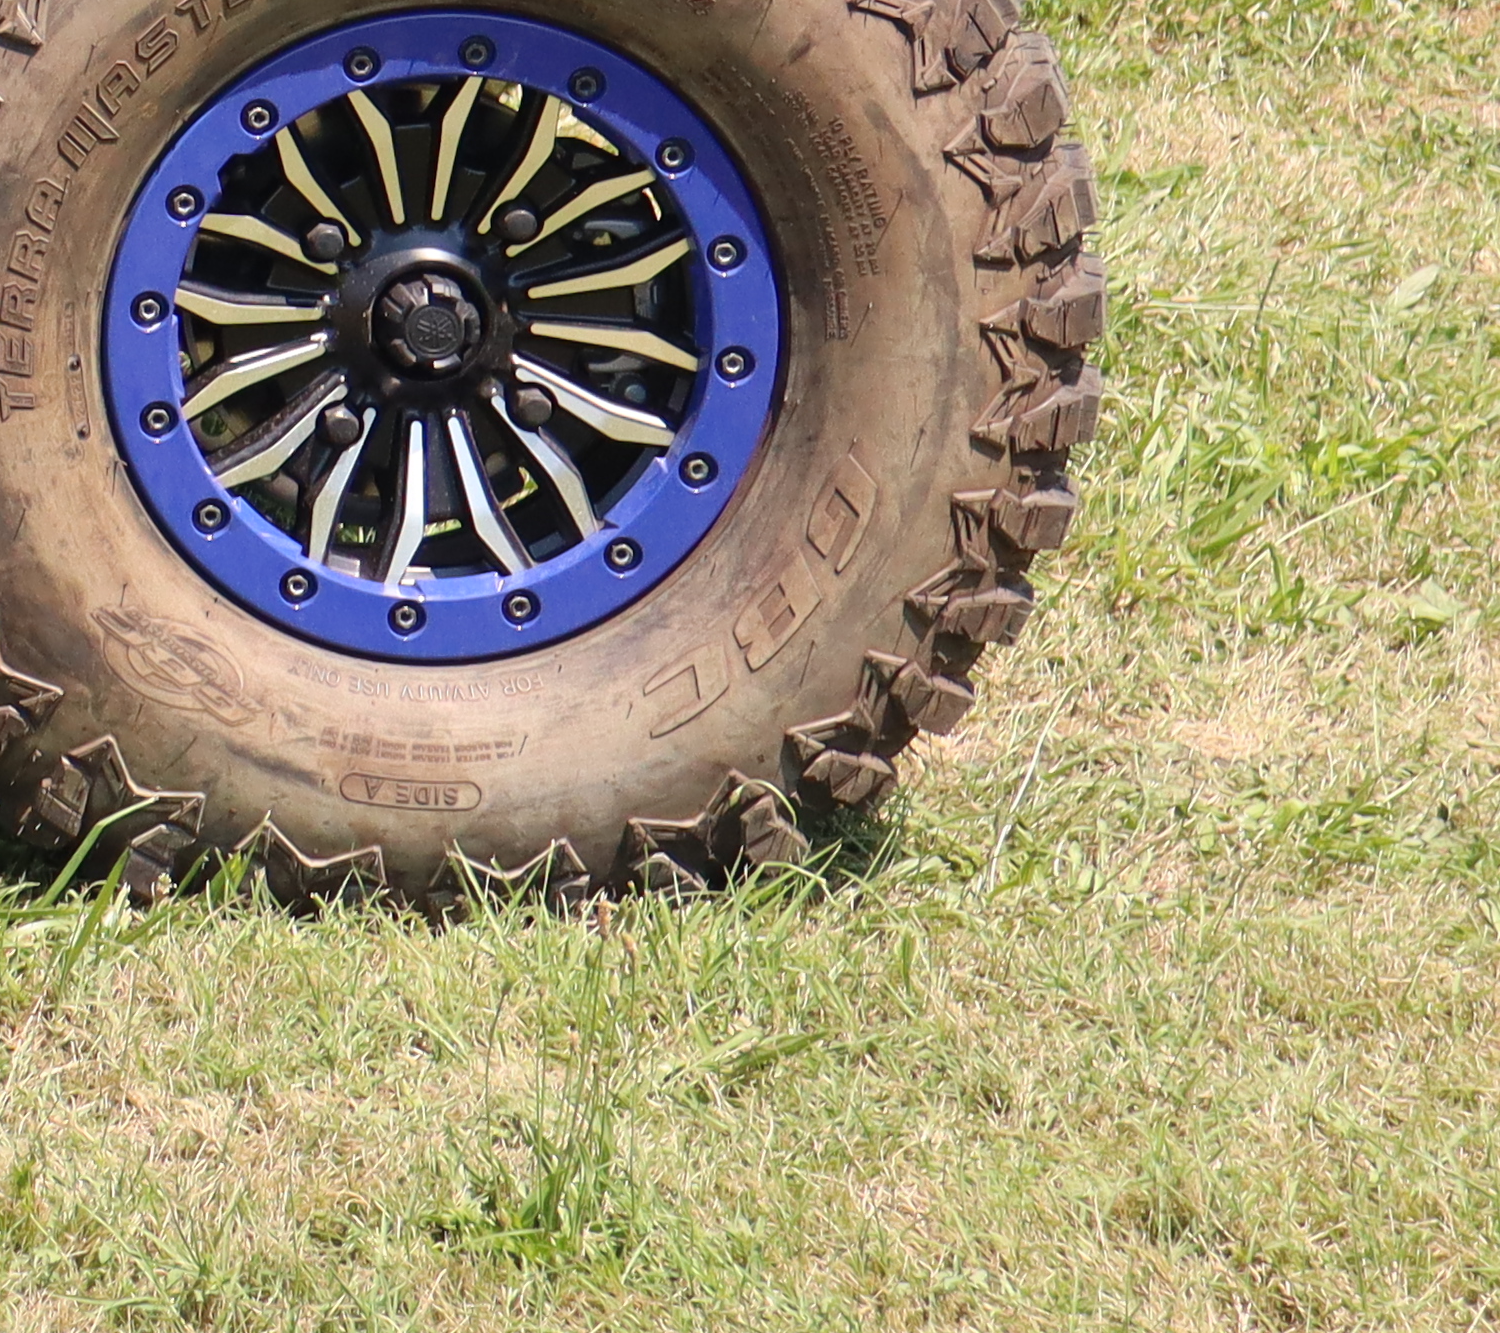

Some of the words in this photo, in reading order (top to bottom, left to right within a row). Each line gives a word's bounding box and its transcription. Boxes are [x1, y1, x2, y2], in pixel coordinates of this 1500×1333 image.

[826, 113, 845, 133] 10
[837, 133, 863, 166] PLY
[853, 165, 887, 230] RATING
[643, 454, 879, 738] GBC
[285, 653, 341, 689] ONLY
[498, 670, 545, 697] FOR
[346, 674, 390, 698] USE
[399, 681, 490, 702] ATV/UTV
[360, 778, 384, 802] A
[394, 783, 458, 806] SIDE
